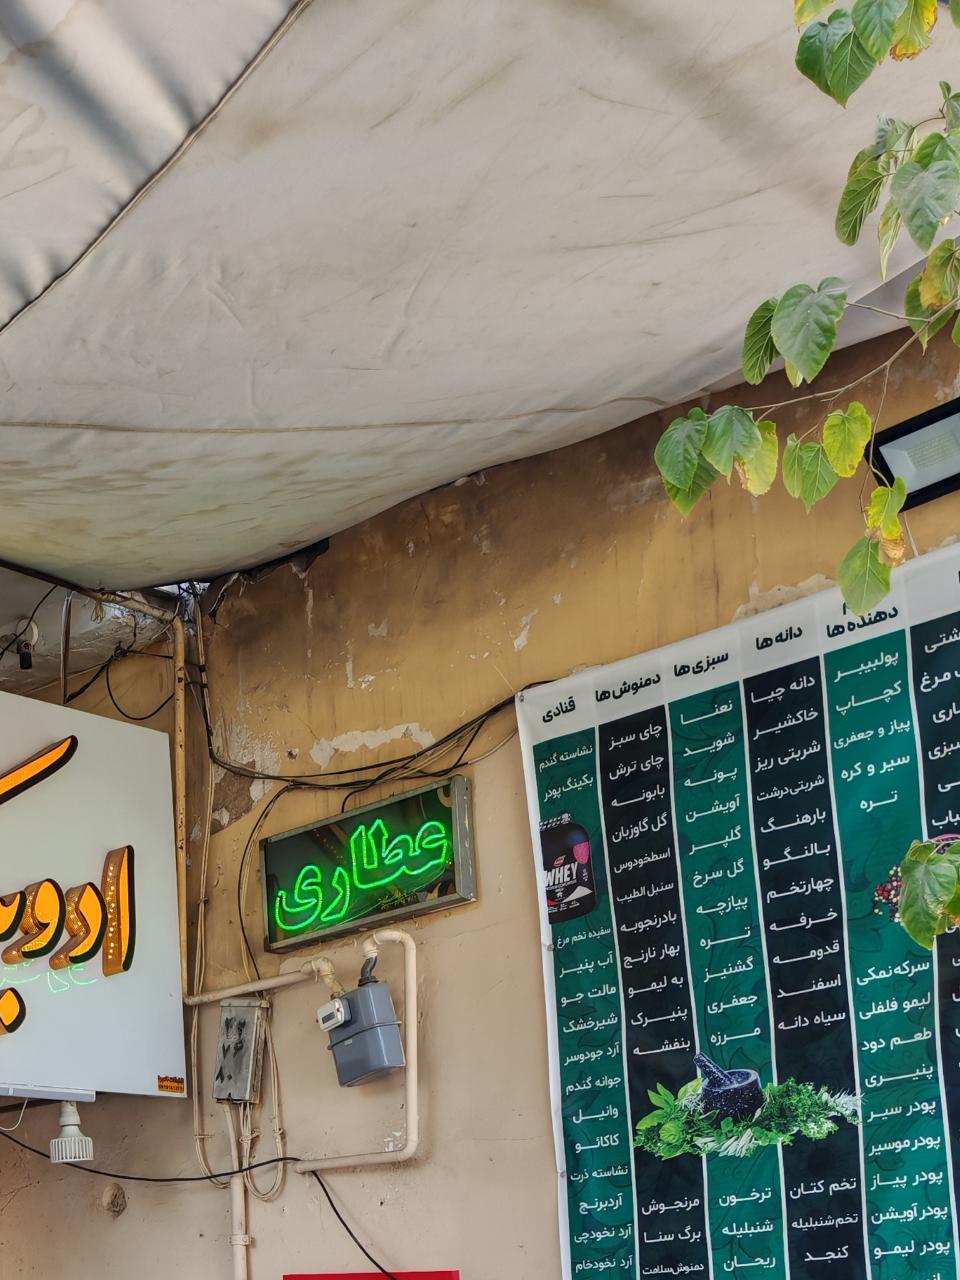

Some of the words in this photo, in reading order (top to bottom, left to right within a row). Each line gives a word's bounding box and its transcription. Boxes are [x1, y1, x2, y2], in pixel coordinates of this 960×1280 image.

[775, 626, 803, 643] دانه
[692, 653, 729, 675] سبزی
[612, 674, 661, 700] دمنوش
[790, 676, 815, 690] دانه
[920, 669, 952, 694] مرغ
[751, 687, 785, 703] چیا
[836, 680, 901, 716] کچاپ
[542, 696, 576, 723] قنادی
[680, 700, 733, 725] نعنا
[639, 724, 662, 741] چای
[753, 708, 818, 740] خاکشیر
[878, 727, 885, 738] و
[888, 719, 911, 735] پیاز
[609, 734, 636, 751] سبز
[683, 732, 735, 757] شوید
[834, 730, 874, 749] جعفری
[559, 745, 593, 761] نشاسته
[778, 740, 821, 765] شربتی
[539, 752, 557, 773] گندم
[609, 763, 637, 780] ترش
[640, 755, 664, 771] چای
[755, 757, 774, 773] ریز
[841, 762, 862, 782] کره
[867, 764, 875, 776] و
[880, 755, 910, 773] سیر
[684, 768, 737, 786] پونه
[611, 784, 665, 806] بابونه
[860, 790, 898, 812] تره
[685, 793, 740, 822] آویشن
[612, 817, 649, 843] گاوزبان
[651, 812, 667, 832] گل
[760, 808, 826, 833] بارهنگ
[689, 825, 741, 855] گلپر
[614, 847, 671, 873] اسطخودوس
[763, 842, 831, 870] بالنگو
[274, 818, 448, 931] عطاری
[543, 862, 578, 886] WHEY
[727, 857, 744, 878] گل
[693, 870, 723, 888] سرخ
[696, 896, 748, 915] پیازچه
[620, 910, 677, 933] بادرنجوبه
[769, 908, 838, 931] خرفه
[700, 926, 751, 950] تره
[597, 951, 613, 966] آب
[624, 947, 656, 969] نارنج
[660, 944, 680, 960] بهار
[773, 939, 840, 964] قدومه
[559, 959, 594, 978] پنیر
[704, 955, 753, 983] گشنیز
[628, 976, 667, 998] لیمو
[671, 975, 685, 986] به
[777, 974, 841, 998] اسفند
[561, 993, 584, 1007] جو
[587, 984, 616, 998] مالت
[707, 995, 758, 1014] جعفری
[859, 1000, 898, 1020] فلفلی
[903, 992, 931, 1013] لیمو
[631, 1006, 687, 1027] پنیرک
[778, 1015, 809, 1030] دانه
[814, 1011, 846, 1026] سیاه
[710, 1027, 761, 1046] مرزه
[861, 1038, 886, 1053] دود
[890, 1027, 932, 1050] طعم
[606, 1041, 620, 1055] آرد
[633, 1038, 690, 1055] بنفشه
[566, 1076, 592, 1095] گندم
[595, 1076, 621, 1088] جوانه
[865, 1064, 933, 1088] پنیری
[572, 1104, 618, 1124] وانیل
[867, 1106, 902, 1122] سیر
[906, 1101, 936, 1116] پودر
[575, 1133, 619, 1153] کاکائو
[868, 1139, 911, 1156] موسیر
[911, 1136, 941, 1151] پودر
[570, 1169, 589, 1183] ذرت
[592, 1165, 628, 1178] نشاسته
[912, 1171, 943, 1186] پودر
[790, 1180, 824, 1199] کتان
[829, 1178, 856, 1196] تخم
[870, 1173, 907, 1191] پیاز
[642, 1198, 700, 1215] مرنجوش
[719, 1188, 771, 1207] ترخون
[871, 1203, 918, 1224] آویشن
[919, 1206, 948, 1220] پودر
[574, 1227, 615, 1244] نخودچی
[618, 1224, 632, 1239] آرد
[644, 1232, 674, 1243] سنا
[678, 1225, 701, 1242] برگ
[722, 1219, 773, 1238] شنبلیله
[804, 1245, 848, 1263] کنجد
[874, 1240, 915, 1259] لیمو
[920, 1242, 950, 1256] پودر
[724, 1256, 776, 1271] ریحان
